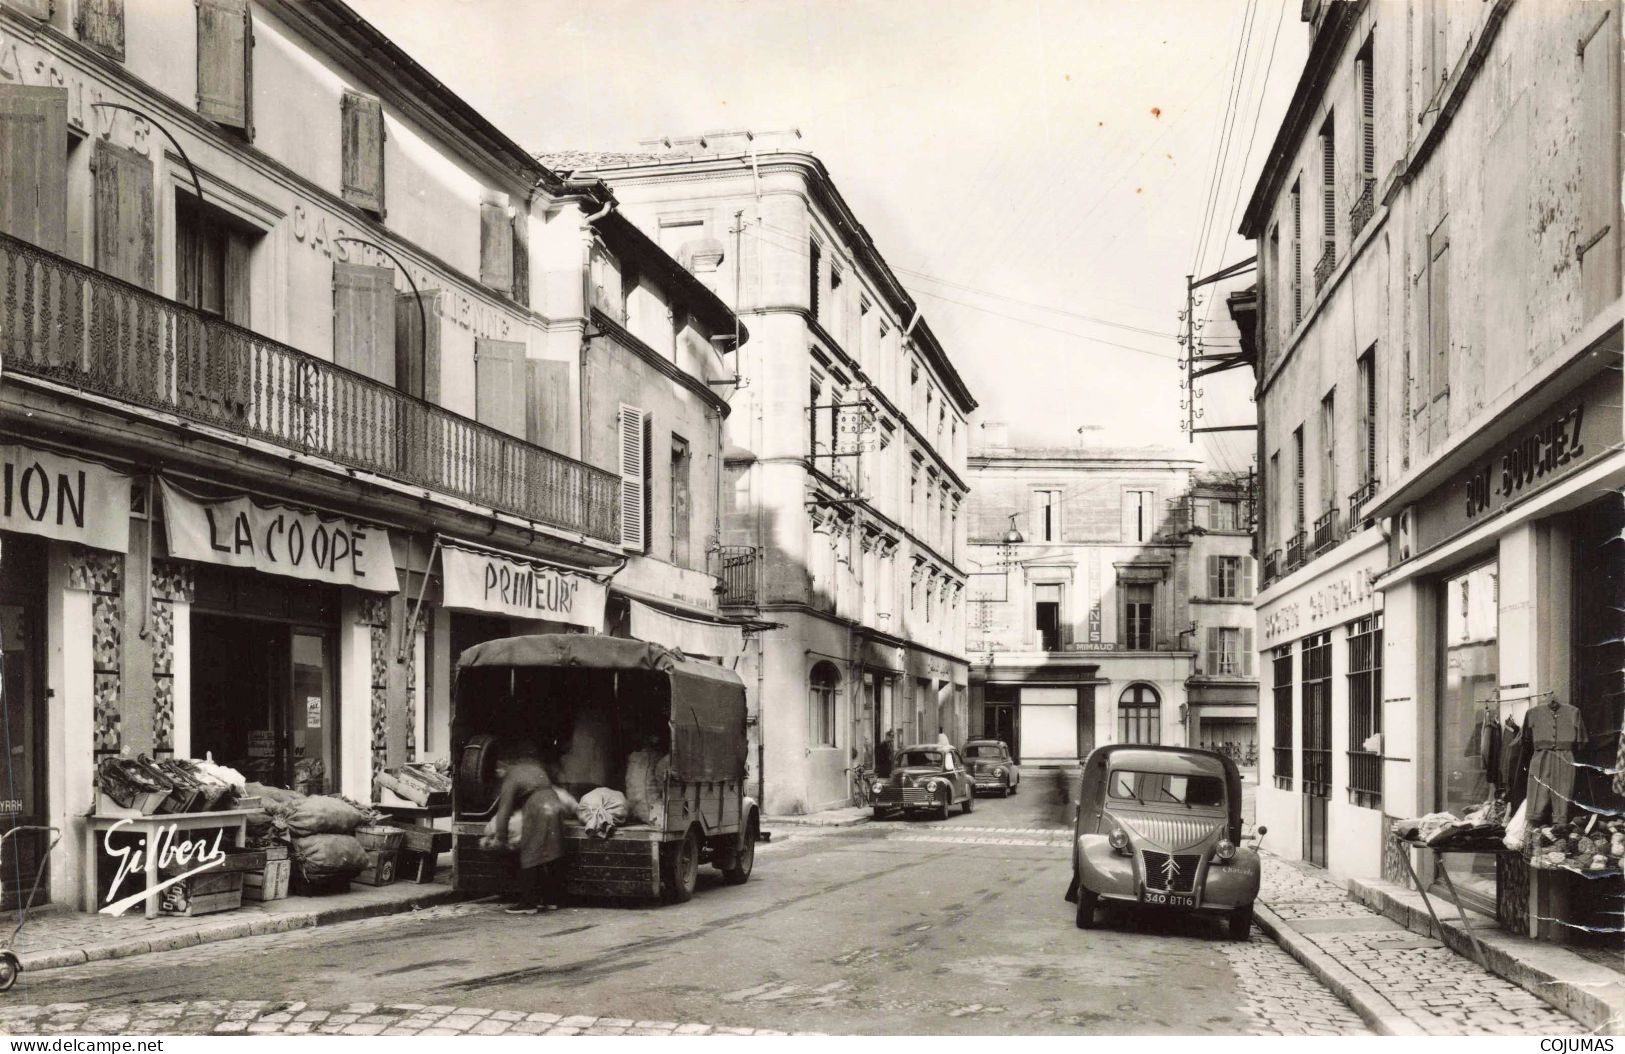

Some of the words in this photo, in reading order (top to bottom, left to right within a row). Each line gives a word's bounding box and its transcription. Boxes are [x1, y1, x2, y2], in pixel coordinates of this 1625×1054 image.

[4, 462, 86, 528] ION
[205, 508, 256, 554] LA
[1076, 643, 1114, 651] MIMAUD
[1145, 893, 1166, 903] 340
[1170, 895, 1193, 906] BT16
